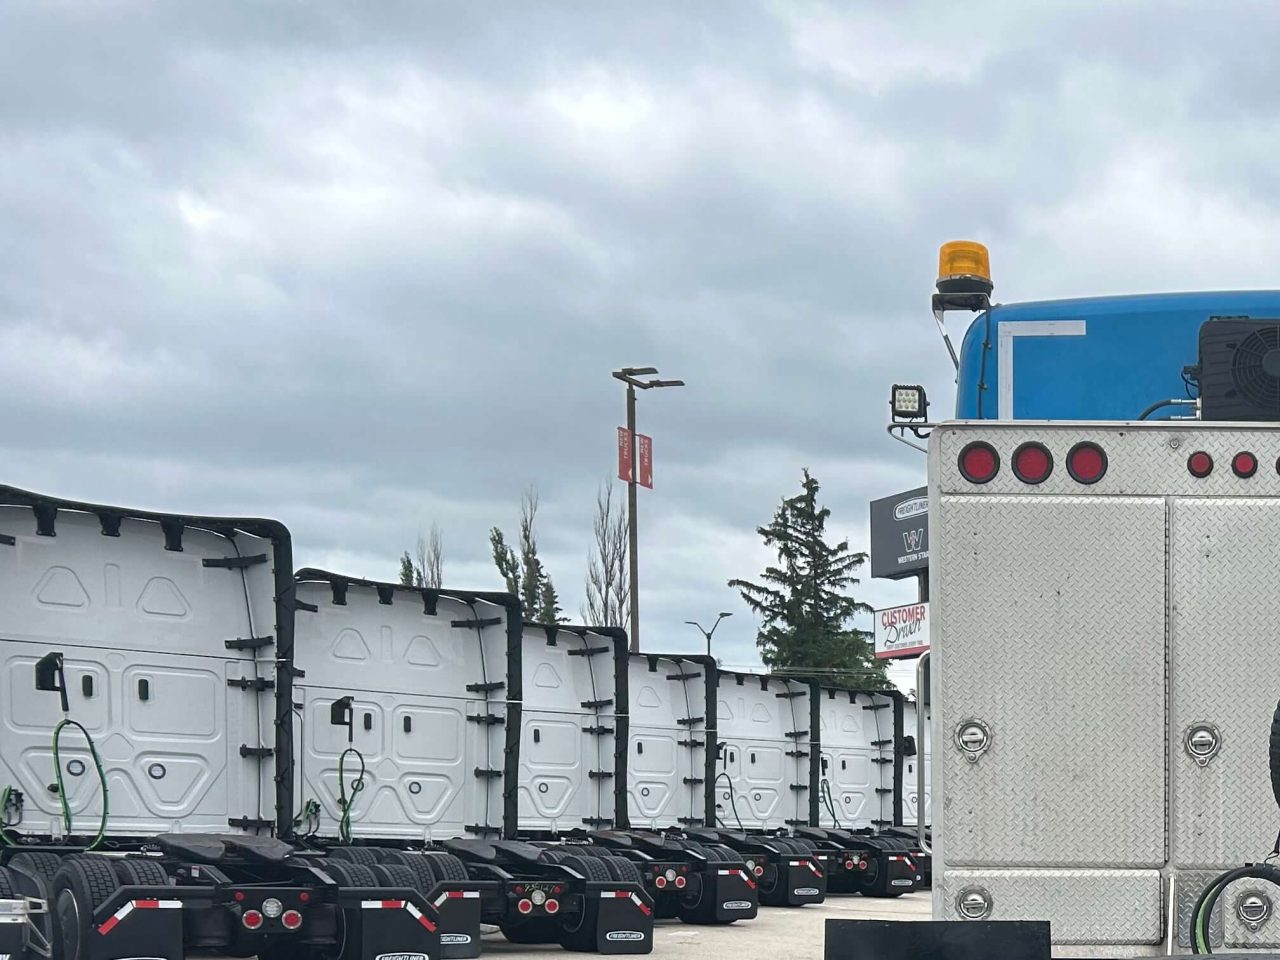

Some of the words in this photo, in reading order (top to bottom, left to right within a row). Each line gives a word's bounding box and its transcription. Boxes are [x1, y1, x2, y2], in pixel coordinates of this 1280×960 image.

[898, 553, 918, 564] WESTERN
[881, 605, 926, 627] CUSTOMER
[884, 620, 921, 647] Driven
